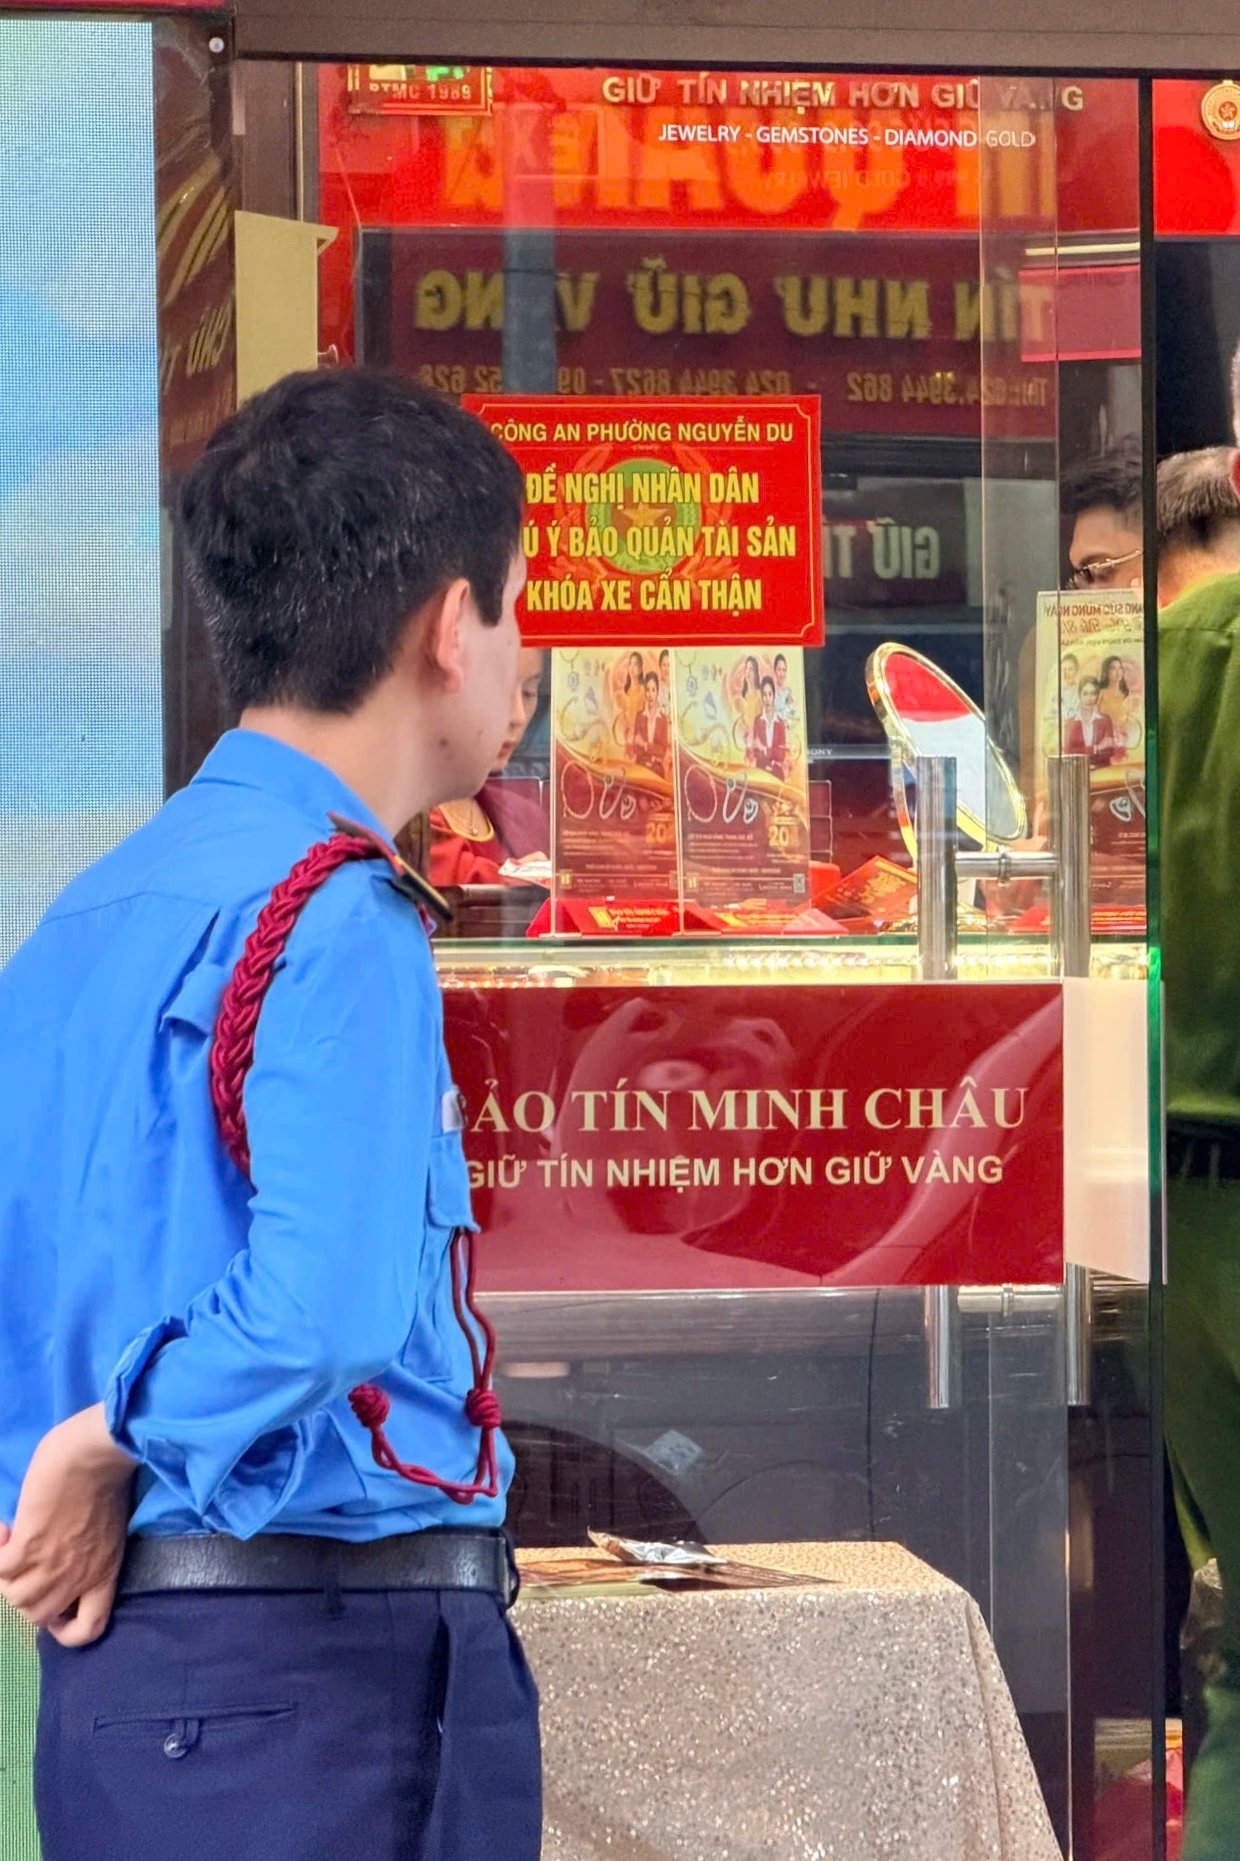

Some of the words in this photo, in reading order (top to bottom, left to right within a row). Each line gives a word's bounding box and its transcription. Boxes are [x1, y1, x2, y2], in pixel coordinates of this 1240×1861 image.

[677, 71, 727, 104] TÍN
[850, 81, 920, 108] HƠN
[658, 124, 741, 142] JEWELRY
[756, 126, 870, 144] GEMSTONES
[885, 128, 977, 147] DIAMOND
[985, 130, 1037, 148] GOLD
[491, 418, 547, 442] CÔNG
[553, 423, 580, 442] AN
[587, 418, 672, 442] PHƯỜNG
[678, 415, 760, 442] NGUYỄN
[766, 422, 794, 442] DU
[565, 472, 625, 511] NGHỊ
[632, 465, 701, 504] NHÂN
[709, 465, 760, 504] DÂN
[523, 519, 540, 558] Ú
[546, 519, 561, 557] Ý
[569, 516, 620, 558] BẢO
[626, 515, 694, 560] QUẢN
[701, 519, 740, 558] TÀI
[747, 515, 797, 558] SẢN
[526, 573, 594, 611] KHÓA
[600, 579, 633, 611] XE
[640, 566, 692, 611] CẨN
[697, 572, 763, 617] THẬN
[470, 1077, 556, 1133] ẢO
[571, 1077, 671, 1133] TÍN
[688, 1088, 849, 1133] MINH
[864, 1075, 1027, 1131] CHÂU
[467, 1154, 528, 1189] GIỮ
[537, 1153, 593, 1188] TÍN
[606, 1155, 721, 1194] NHIỆM
[733, 1155, 813, 1188] HƠN
[824, 1154, 893, 1186] GIỮ
[901, 1151, 1005, 1185] VÀNG
